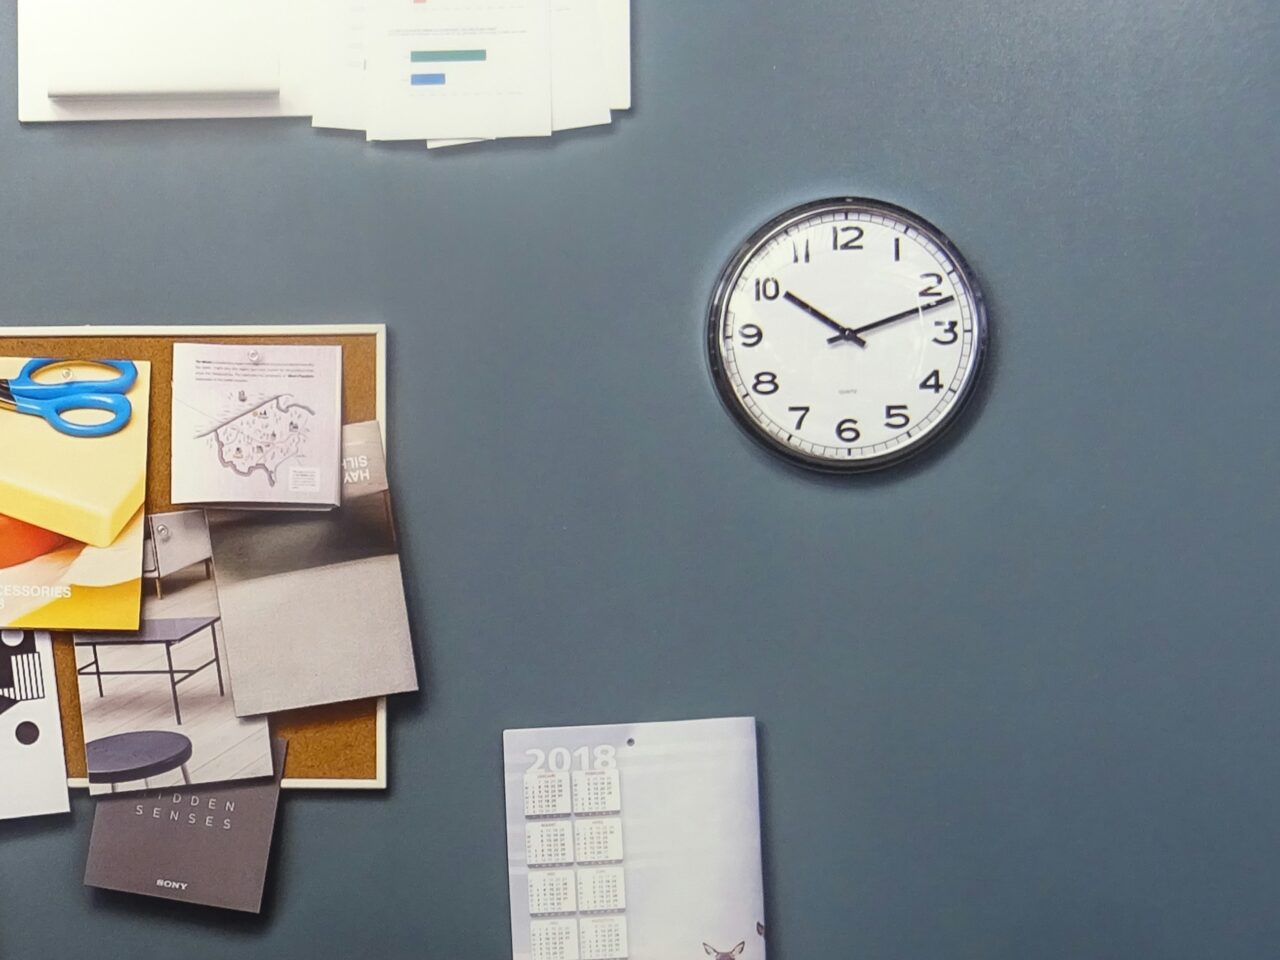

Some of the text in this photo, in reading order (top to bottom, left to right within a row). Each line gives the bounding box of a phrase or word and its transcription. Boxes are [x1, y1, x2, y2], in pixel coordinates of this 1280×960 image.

[832, 226, 864, 250] 12
[894, 238, 900, 262] 1
[793, 238, 810, 263] 11
[755, 277, 780, 301] 10
[918, 272, 943, 298] 2
[738, 324, 763, 348] 9
[932, 320, 959, 345] 3
[752, 372, 780, 395] 8
[919, 369, 944, 394] 4
[788, 406, 811, 430] 7
[884, 405, 911, 430] 5
[835, 418, 861, 443] 6
[343, 468, 370, 484] HAY
[525, 744, 617, 774] 2018
[135, 804, 232, 829] SENSES
[156, 879, 188, 890] SONY
